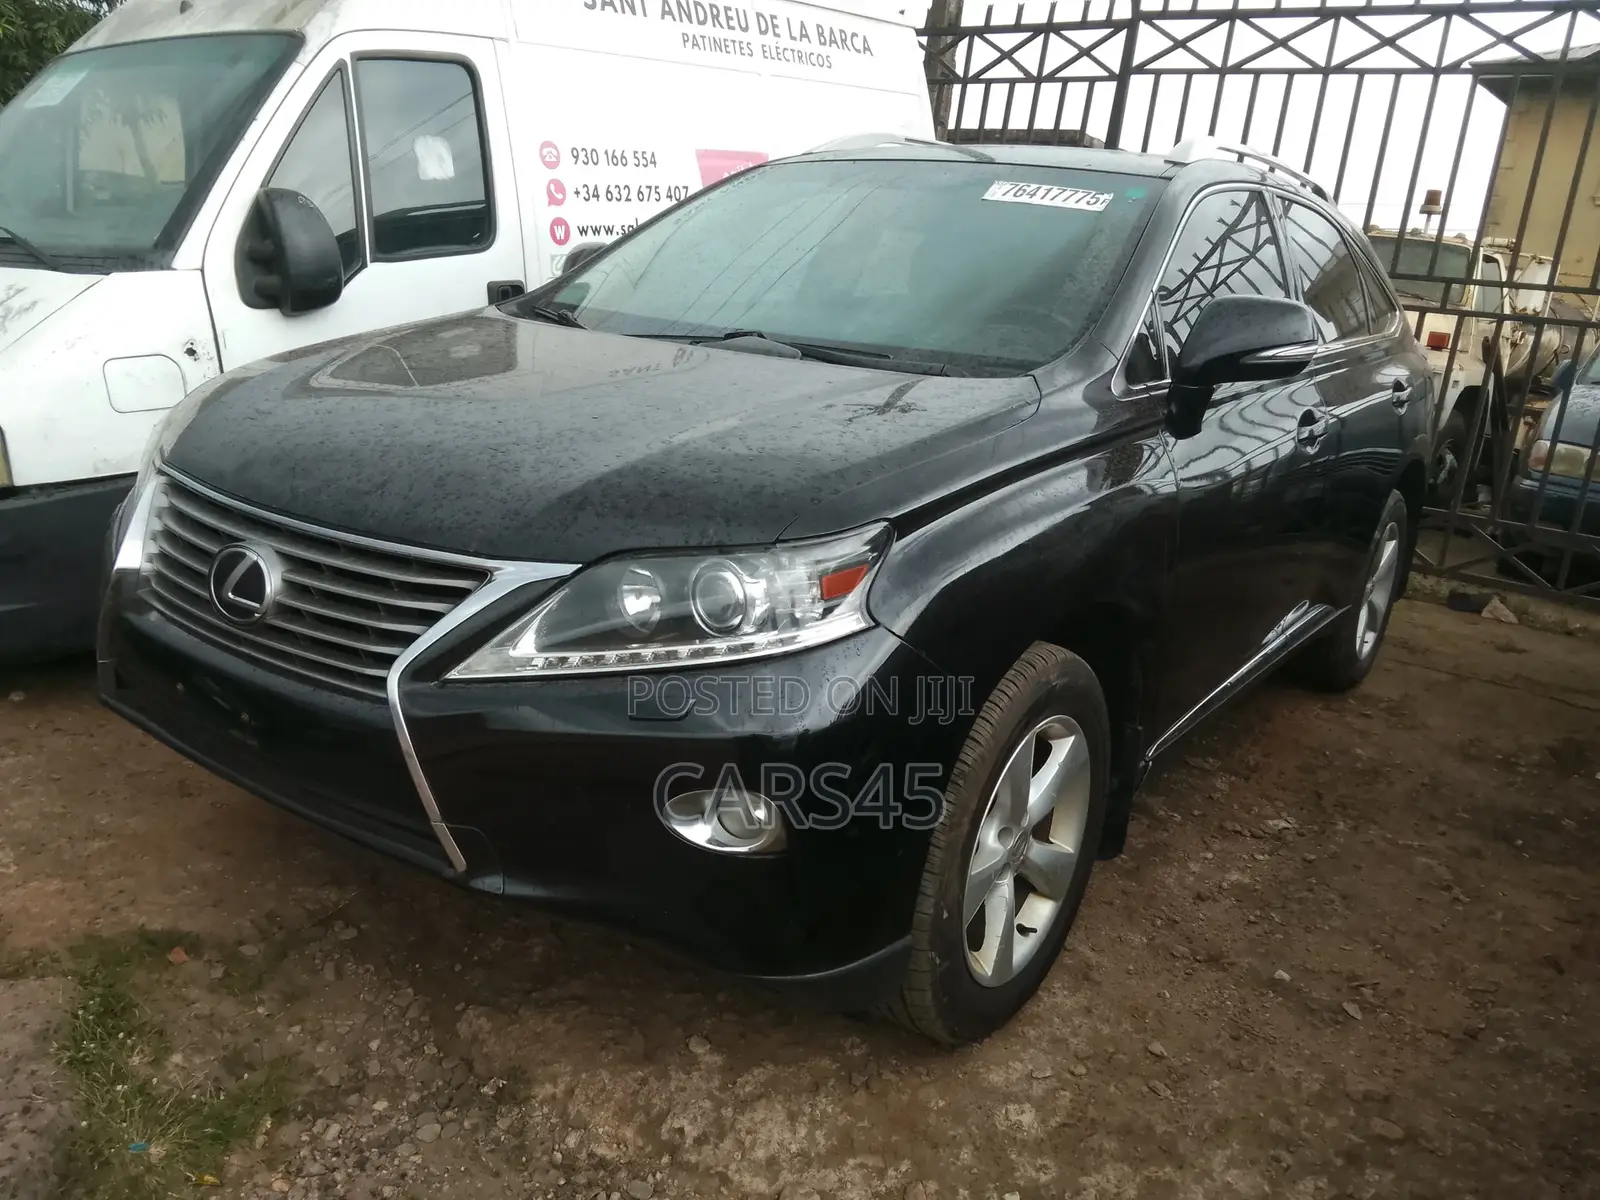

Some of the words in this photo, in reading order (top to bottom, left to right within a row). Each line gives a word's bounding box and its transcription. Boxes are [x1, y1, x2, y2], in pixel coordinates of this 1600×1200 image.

[660, 0, 750, 33] ANDREU
[755, 11, 782, 39] DE
[786, 16, 812, 44] LA
[815, 23, 874, 57] BARCA
[681, 32, 754, 58] PATINETES
[761, 41, 833, 69] ELÉCTRICOS
[570, 147, 600, 166] 930
[604, 148, 629, 167] 166
[633, 150, 658, 169] 554
[573, 184, 601, 203] +34
[605, 185, 631, 203] 632
[637, 185, 662, 203] 675
[665, 185, 689, 203] 407
[1001, 182, 1103, 206] 76417775
